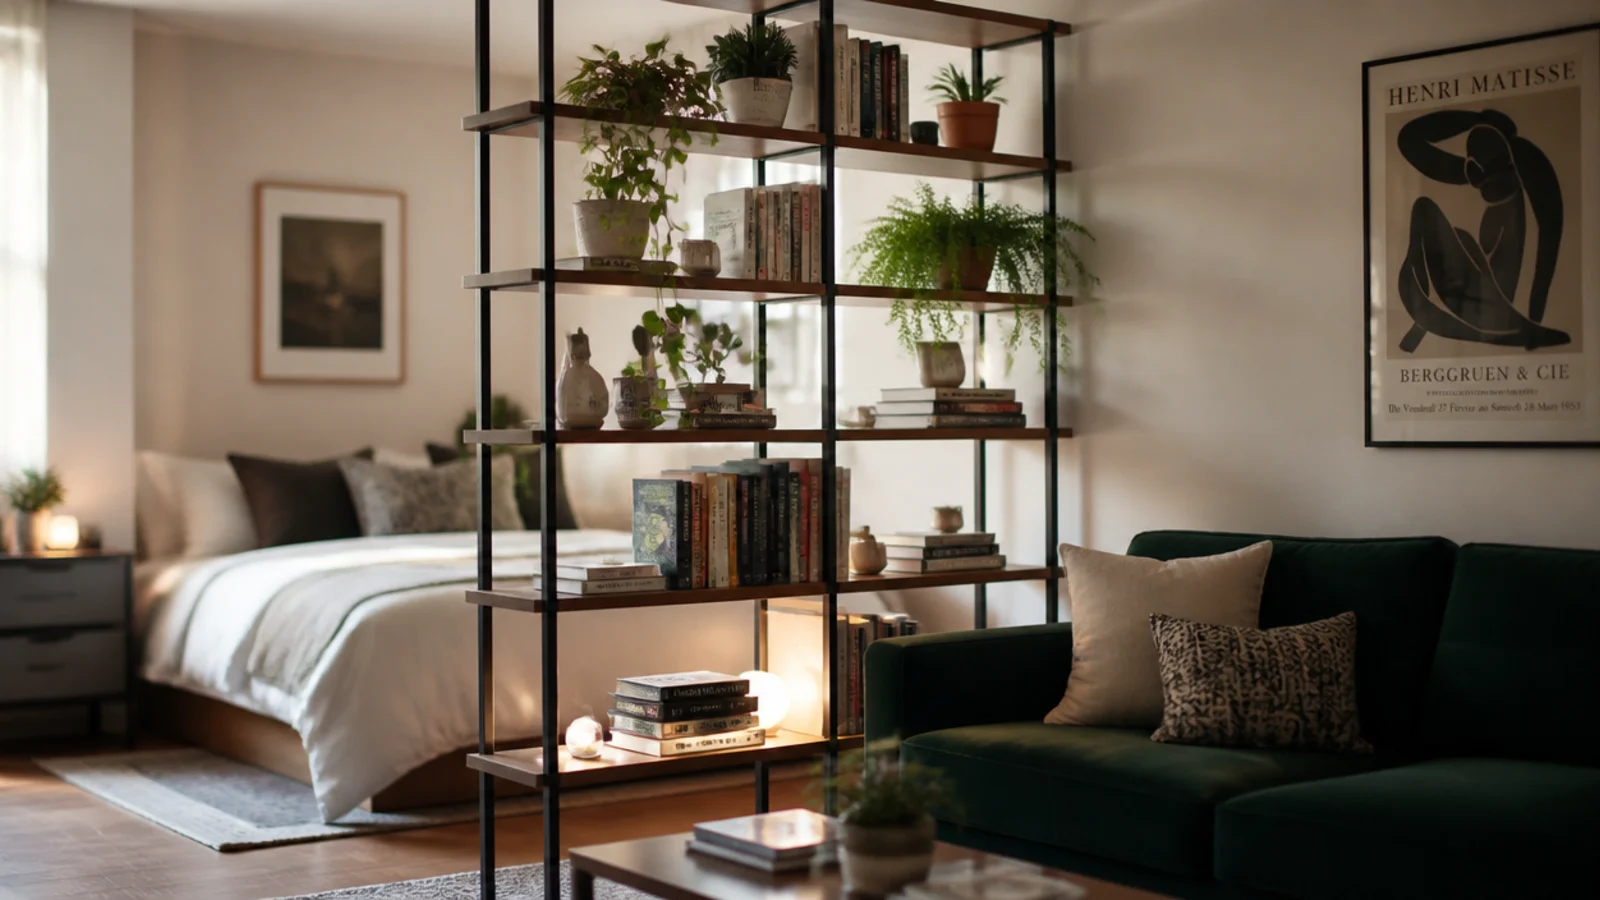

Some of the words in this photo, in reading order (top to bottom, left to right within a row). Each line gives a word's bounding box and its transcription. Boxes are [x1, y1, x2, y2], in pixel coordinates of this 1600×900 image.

[1389, 78, 1460, 106] HENRI
[1471, 60, 1577, 95] MATISSE
[1400, 366, 1510, 383] BERGGRUEN
[1516, 366, 1529, 381] &
[1536, 364, 1570, 380] CIE
